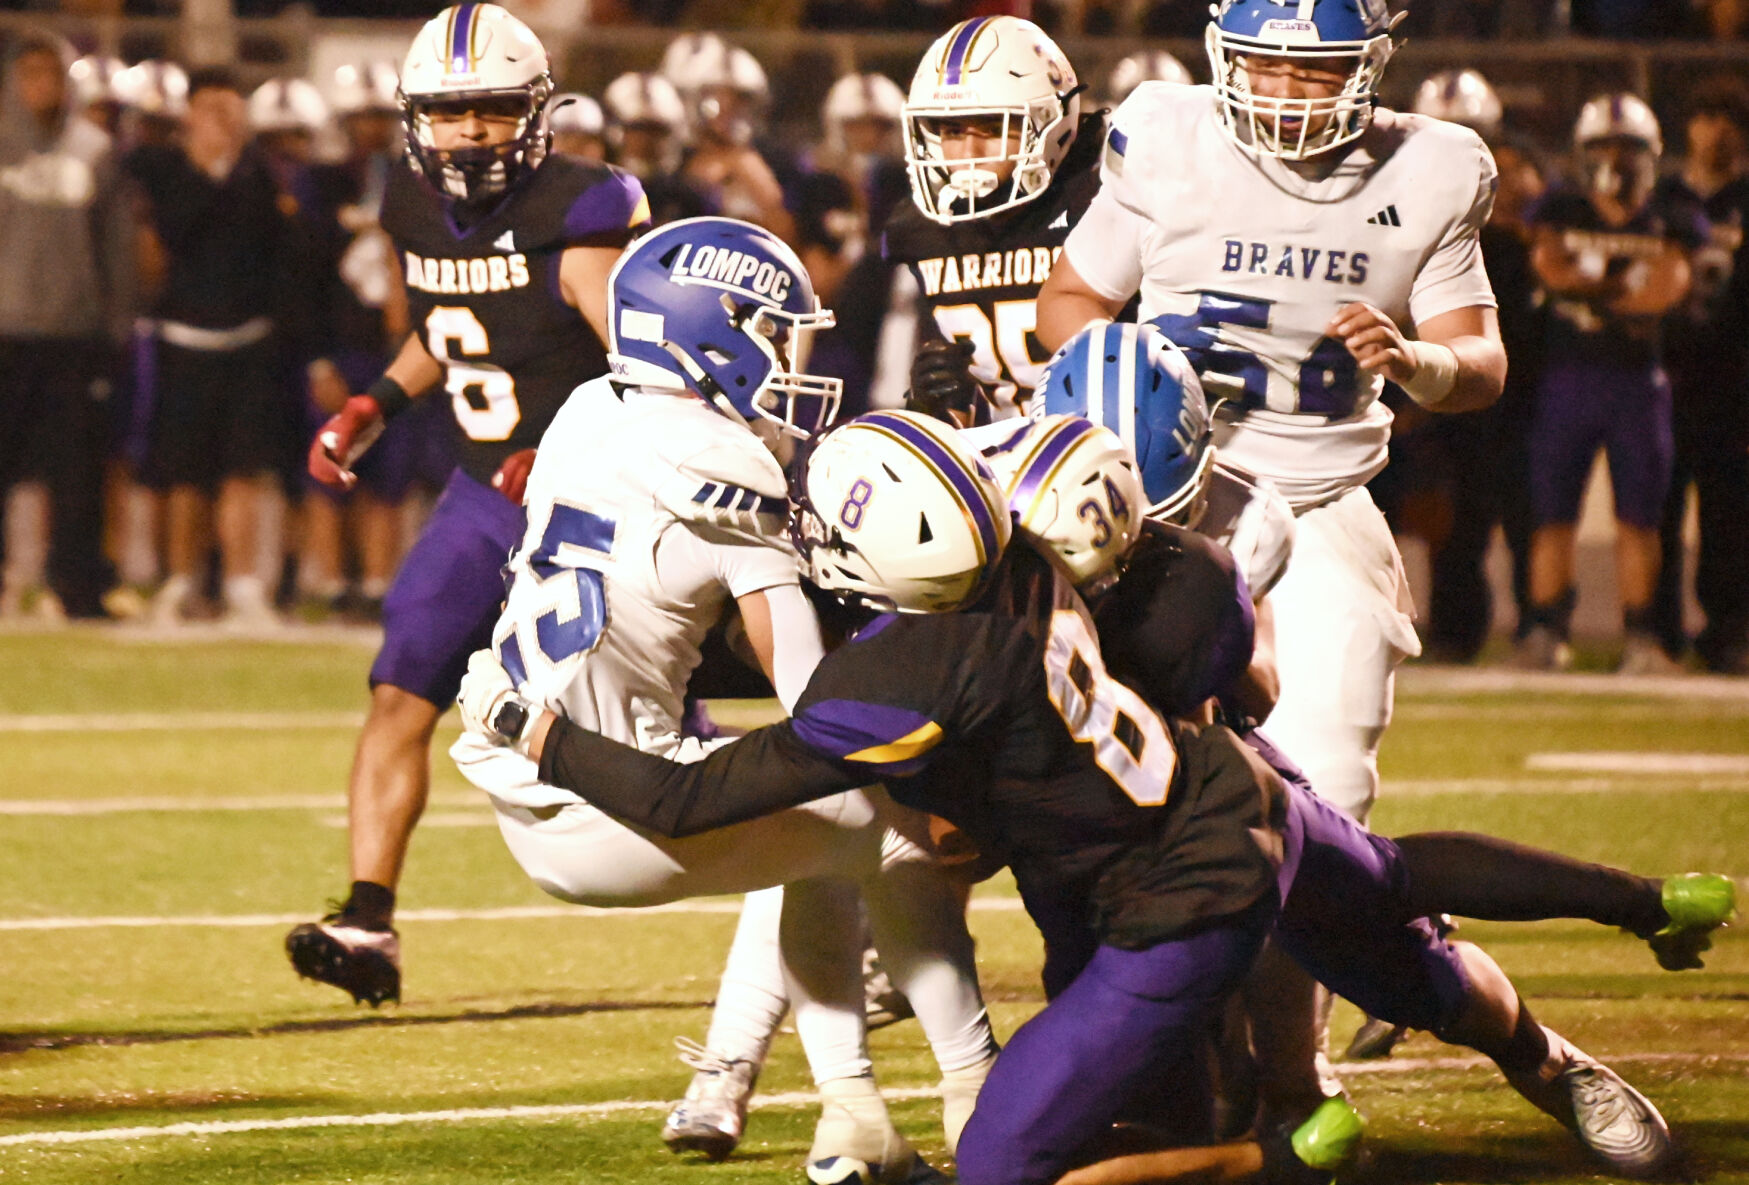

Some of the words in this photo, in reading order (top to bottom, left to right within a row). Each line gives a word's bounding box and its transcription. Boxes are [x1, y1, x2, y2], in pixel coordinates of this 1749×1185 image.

[672, 243, 791, 302] LOMPOC
[1222, 240, 1370, 285] BRAVES
[425, 304, 523, 442] 6
[839, 476, 876, 533] 8
[1077, 474, 1130, 550] 34
[1043, 608, 1178, 807] 8
